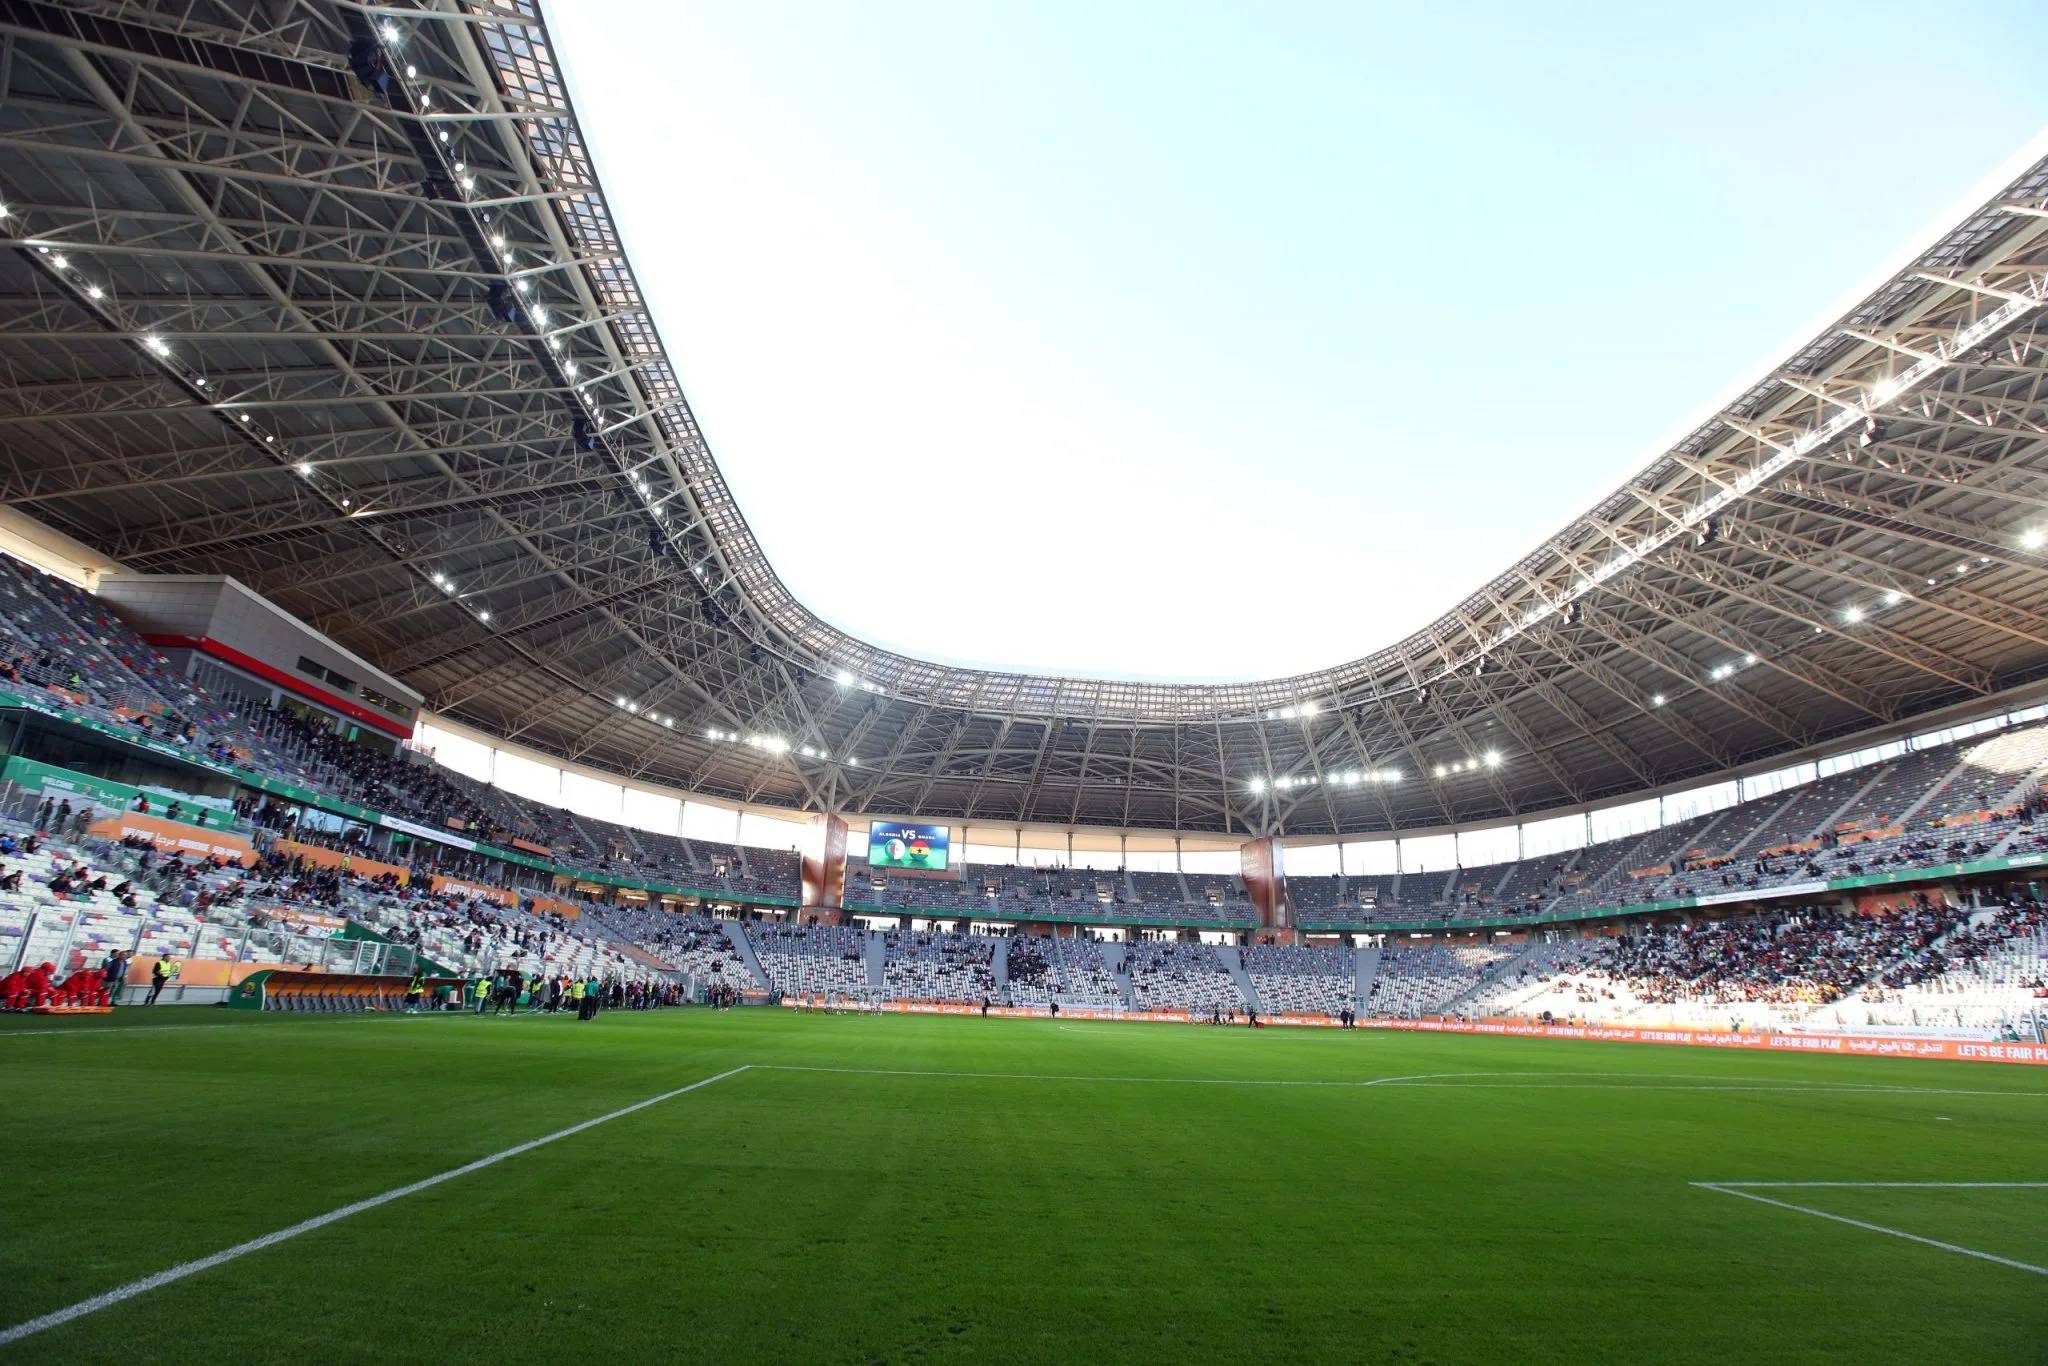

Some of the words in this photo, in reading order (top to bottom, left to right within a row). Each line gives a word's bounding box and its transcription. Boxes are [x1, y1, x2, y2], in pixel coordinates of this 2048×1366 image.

[902, 829, 916, 840] VS
[1770, 1036, 1790, 1047] LET'S
[1791, 1037, 1802, 1048] BE
[1802, 1038, 1819, 1048] FAIR
[1820, 1038, 1840, 1049] PLAY
[1958, 1044, 1988, 1057] LET'S
[1989, 1045, 2004, 1058] BE
[2007, 1046, 2033, 1059] FAIR
[2035, 1048, 2048, 1060] PL
